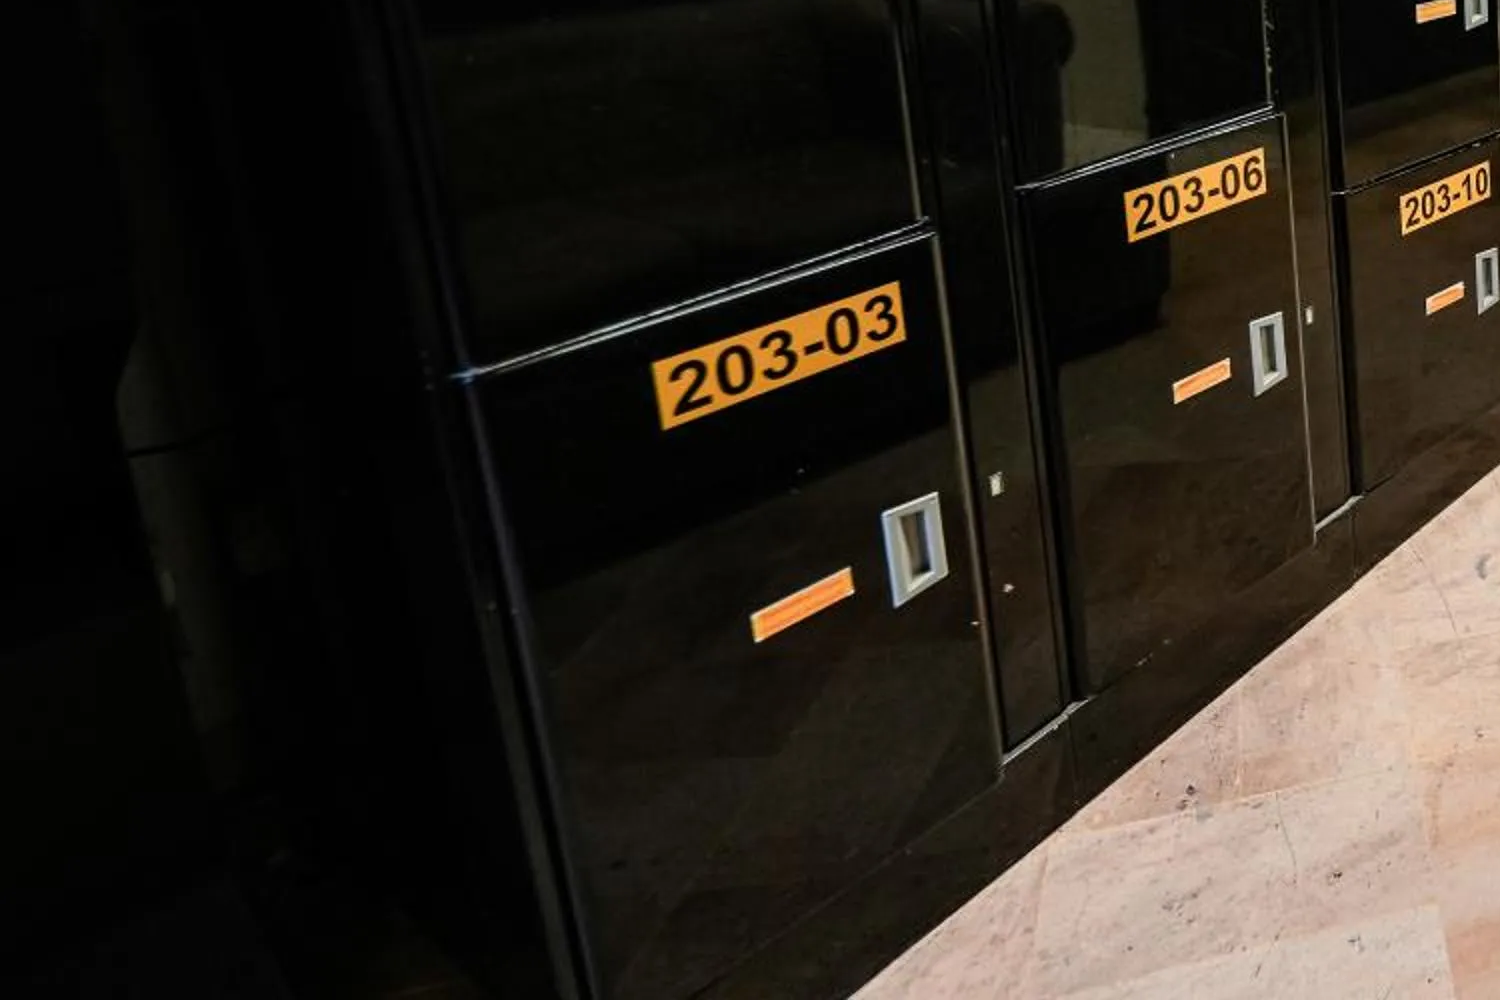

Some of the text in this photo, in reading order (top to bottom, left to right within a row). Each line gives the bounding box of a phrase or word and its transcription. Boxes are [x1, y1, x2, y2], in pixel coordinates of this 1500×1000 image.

[1132, 155, 1263, 233] 203-06
[1405, 167, 1488, 228] 203-10
[669, 294, 897, 417] 203-03
